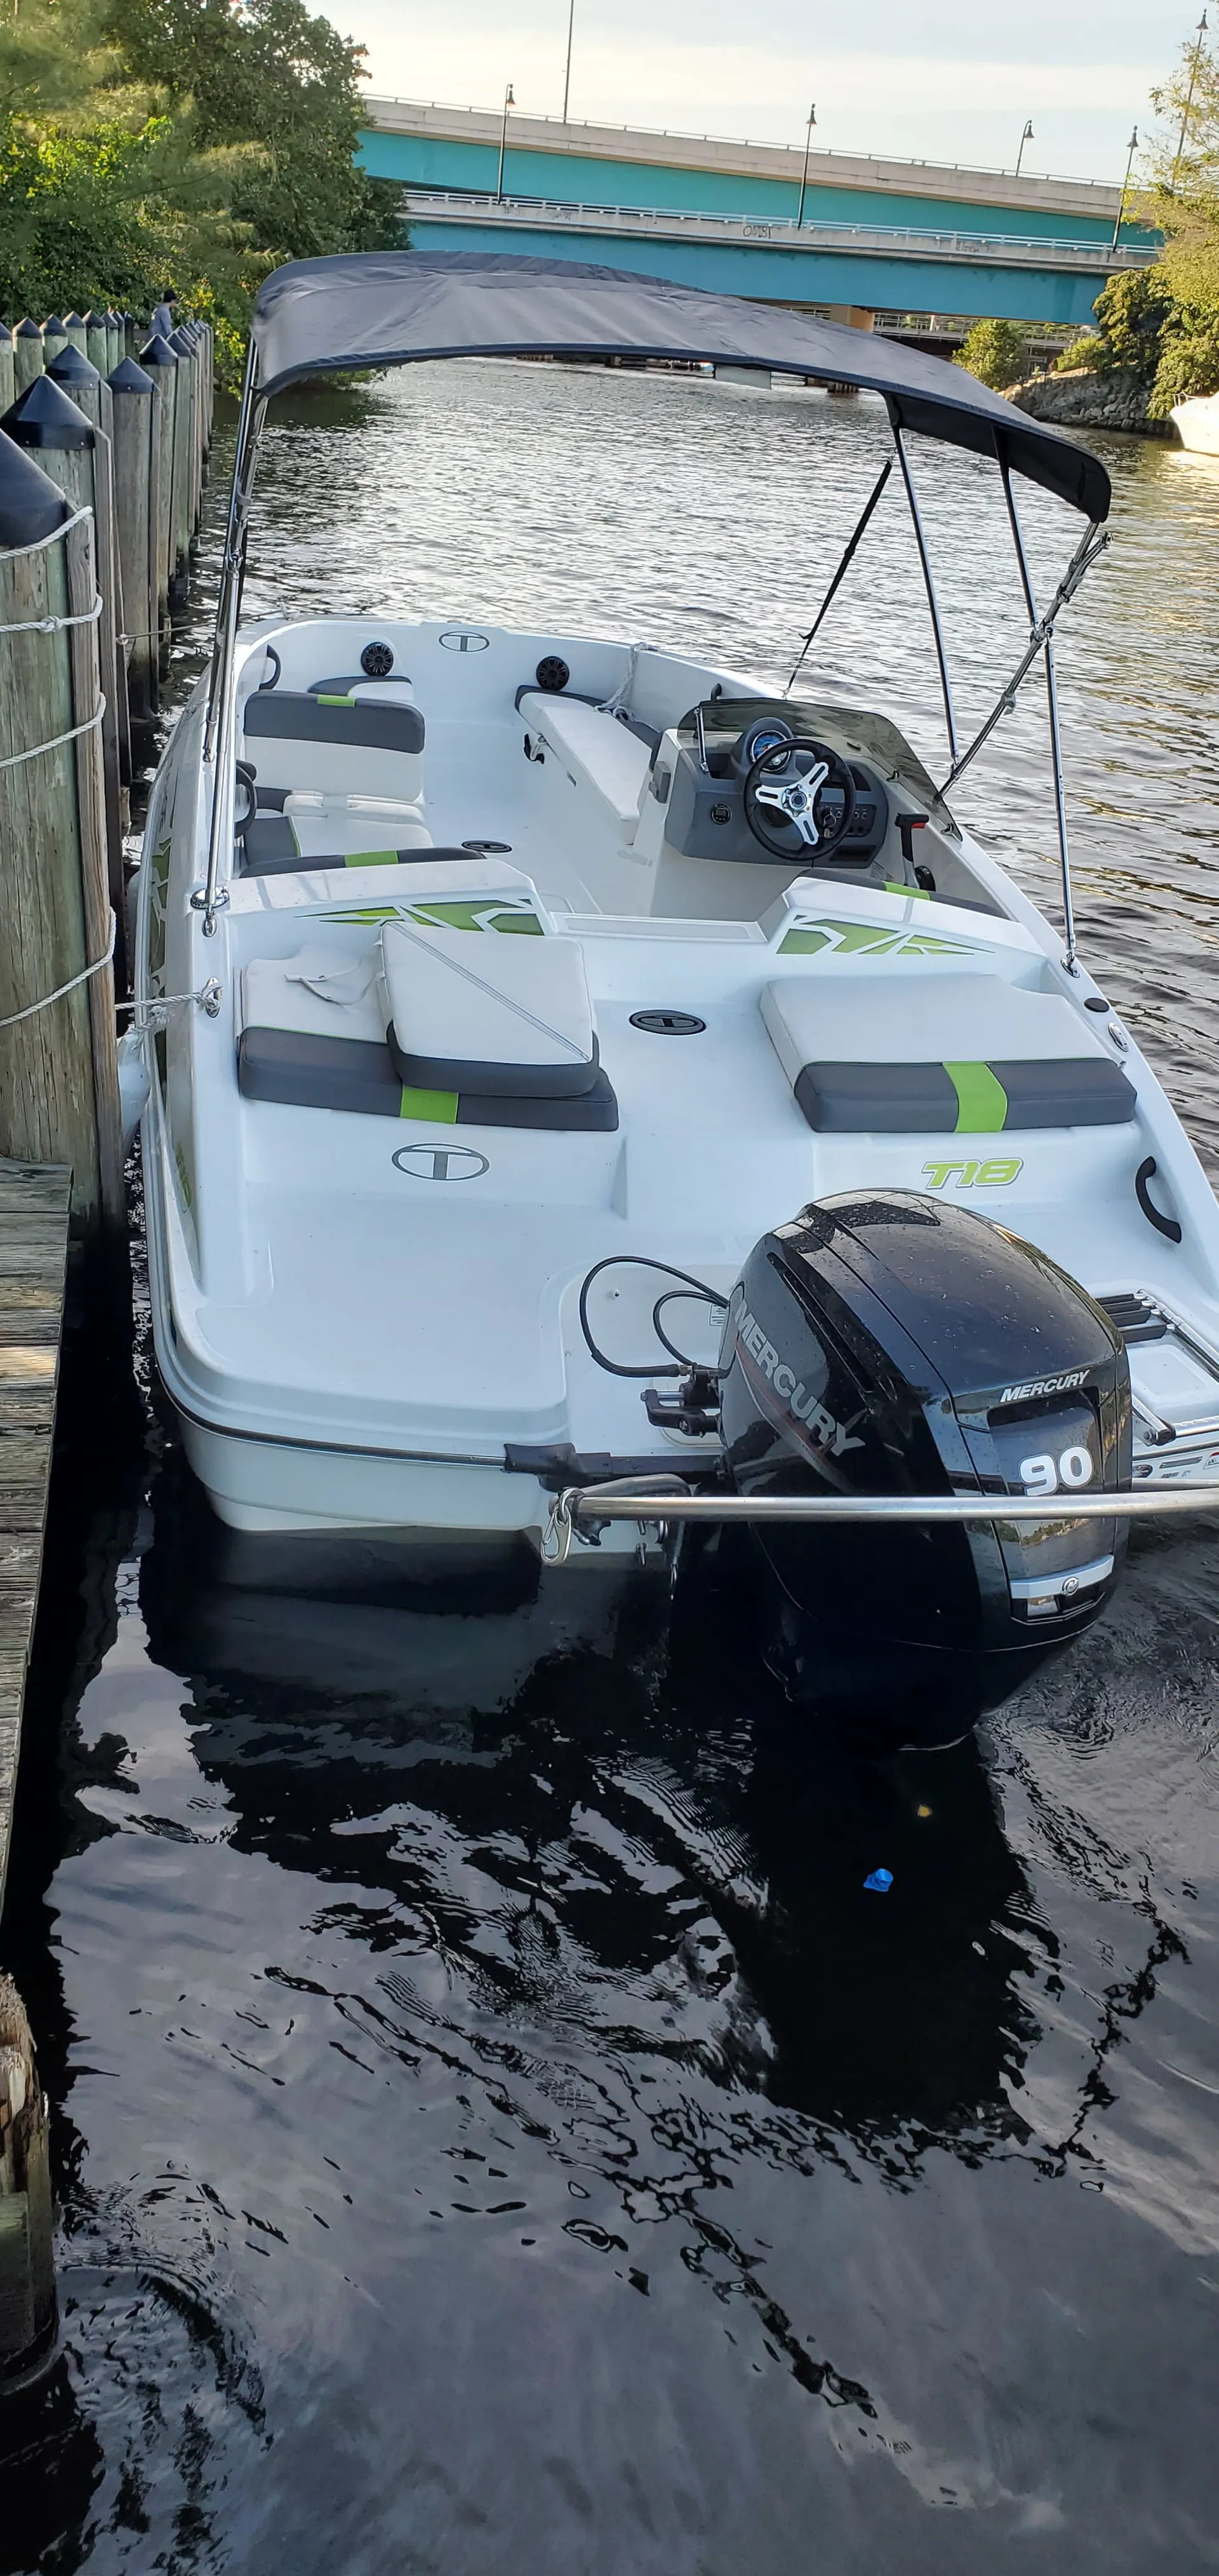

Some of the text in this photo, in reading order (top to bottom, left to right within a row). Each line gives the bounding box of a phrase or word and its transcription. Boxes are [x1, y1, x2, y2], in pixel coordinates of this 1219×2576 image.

[922, 1158, 1023, 1189] T18
[735, 1298, 865, 1457] MERCURY
[1000, 1370, 1090, 1403] MERCURY
[1019, 1445, 1093, 1496] 90
